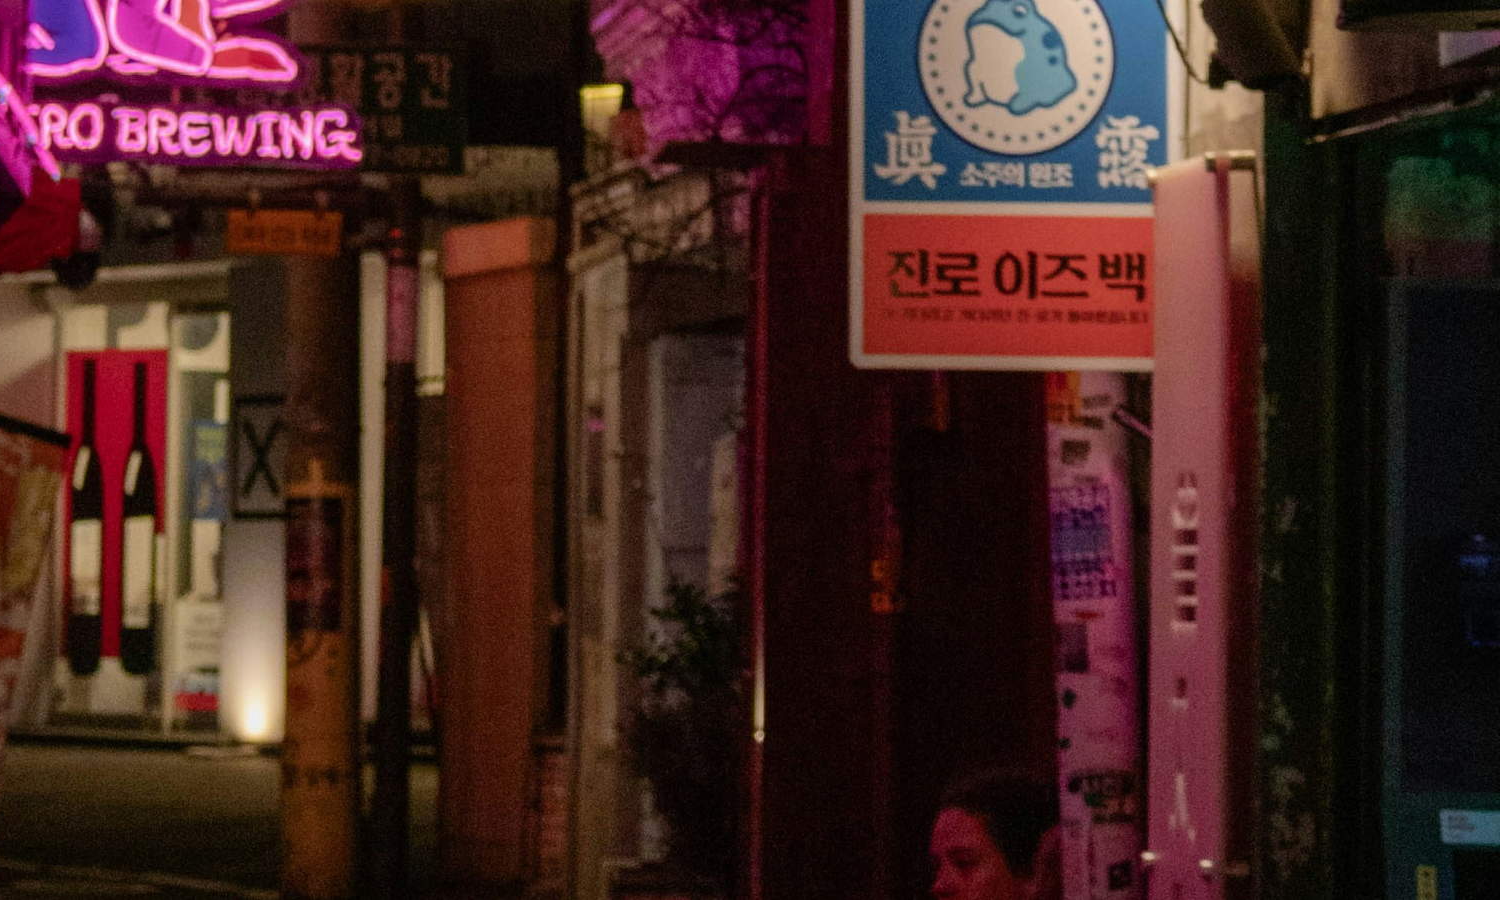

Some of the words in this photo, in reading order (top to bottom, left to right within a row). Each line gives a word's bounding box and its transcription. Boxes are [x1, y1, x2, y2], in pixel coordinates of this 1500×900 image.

[27, 102, 104, 151] RO
[110, 107, 363, 163] BREWING
[959, 162, 1025, 188] 소주의
[1029, 162, 1074, 188] 원조
[887, 248, 981, 298] 진로
[993, 250, 1089, 299] 이즈
[1098, 252, 1147, 302] 백
